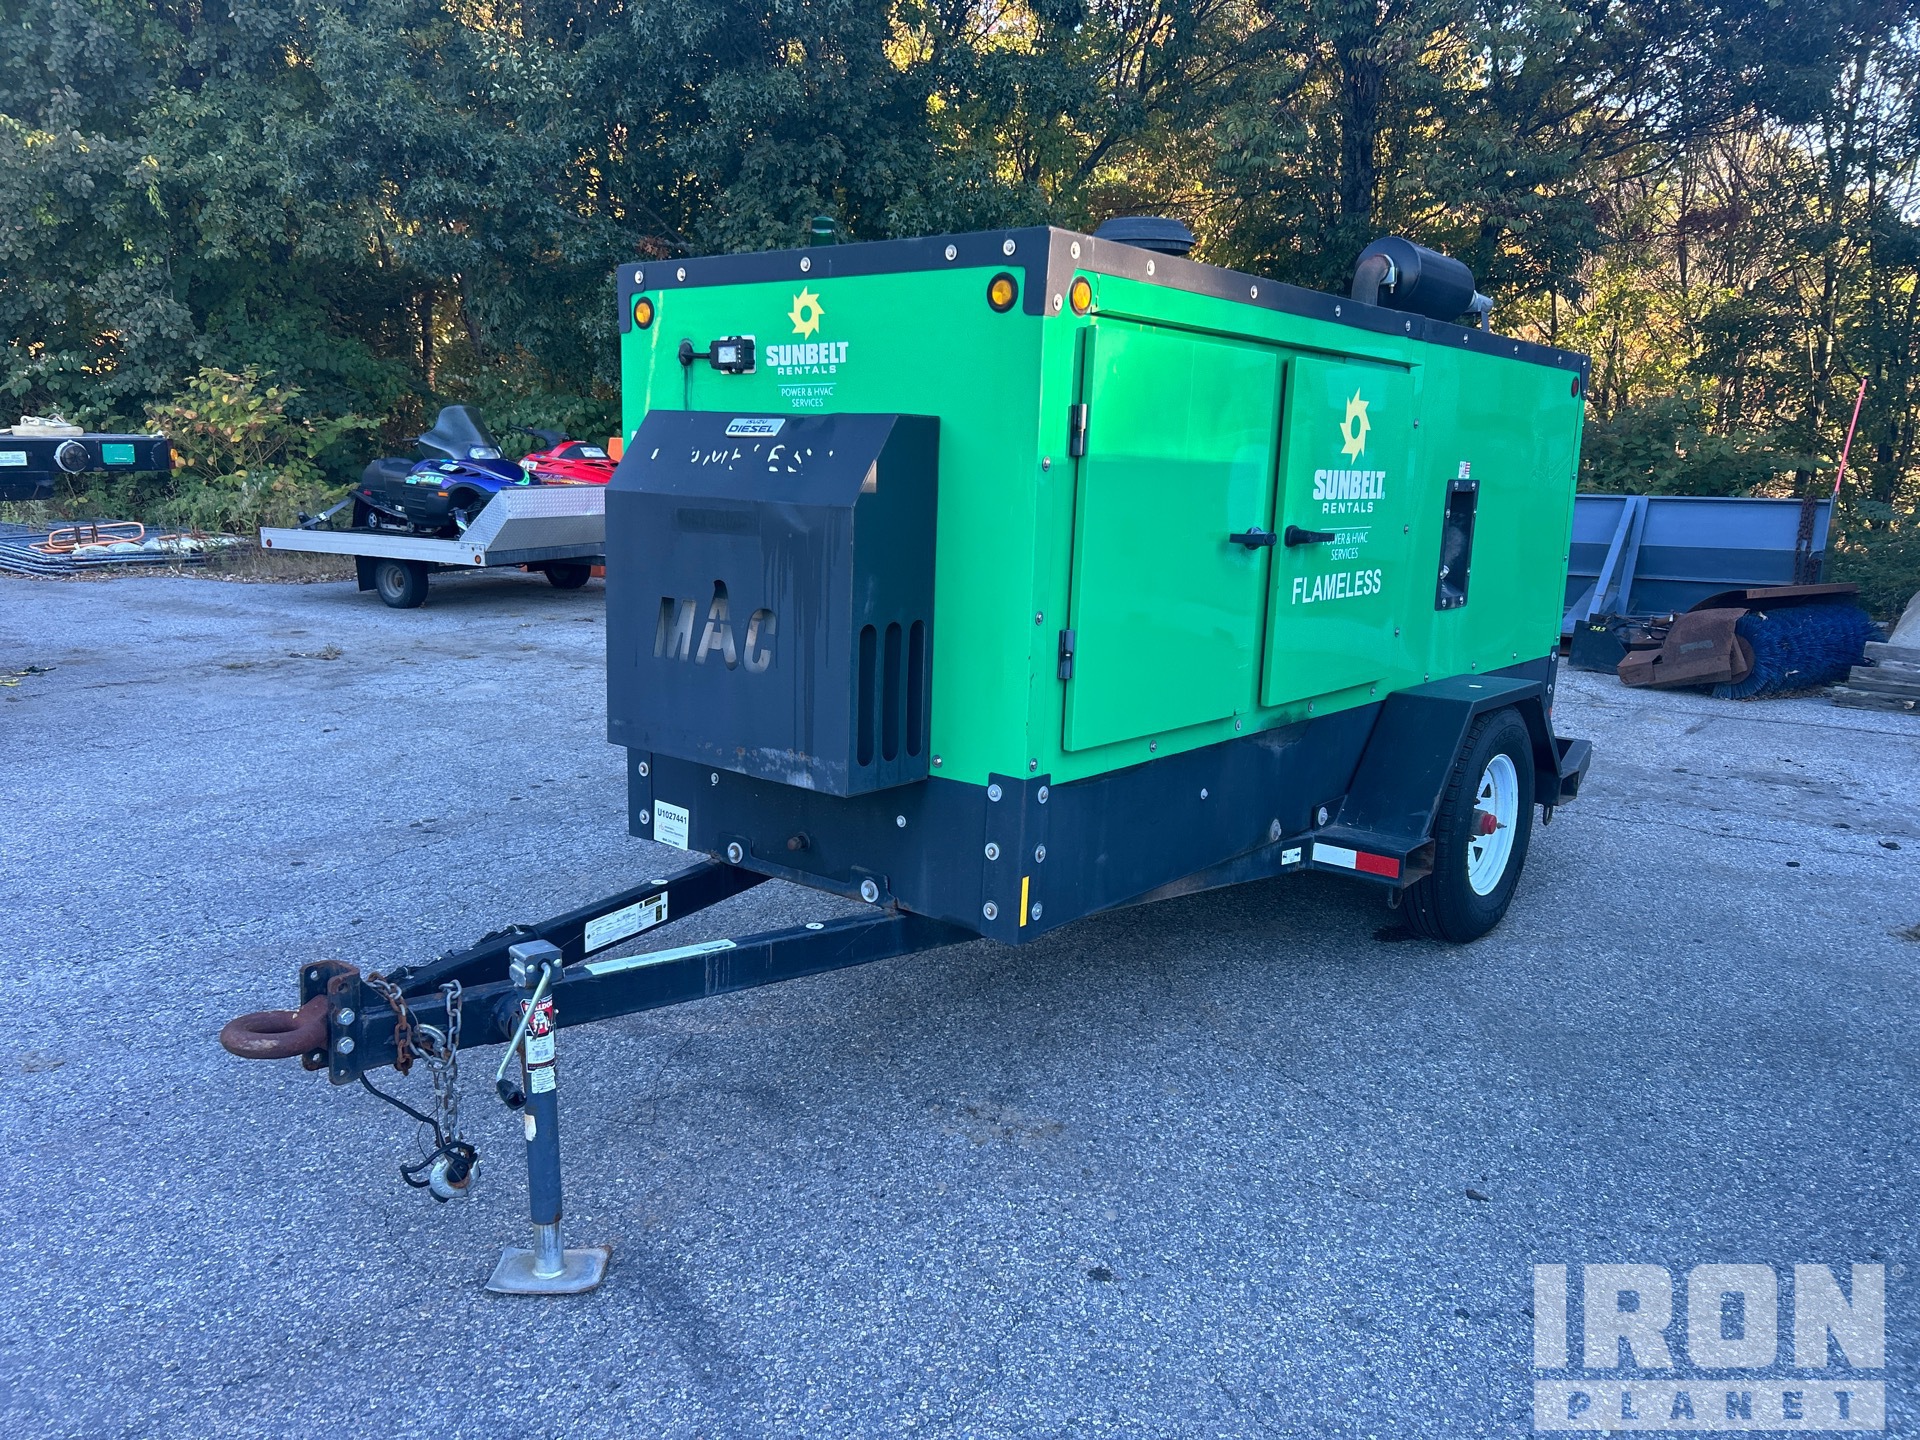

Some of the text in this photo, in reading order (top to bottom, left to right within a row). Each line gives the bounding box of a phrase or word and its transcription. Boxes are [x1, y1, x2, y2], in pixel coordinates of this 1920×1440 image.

[766, 341, 849, 366] SUNBELT
[777, 366, 837, 376] RENTALS
[781, 388, 806, 397] POWER
[814, 387, 834, 396] HVAC
[792, 398, 824, 407] SERVICES
[728, 424, 774, 433] DIESEL
[1313, 469, 1386, 501] SUNBELT
[1322, 502, 1374, 514] RENTALS
[1331, 547, 1359, 561] SERVICES
[1291, 568, 1382, 605] FLAMELESS
[652, 579, 777, 673] MAC
[657, 808, 687, 824] U1027441
